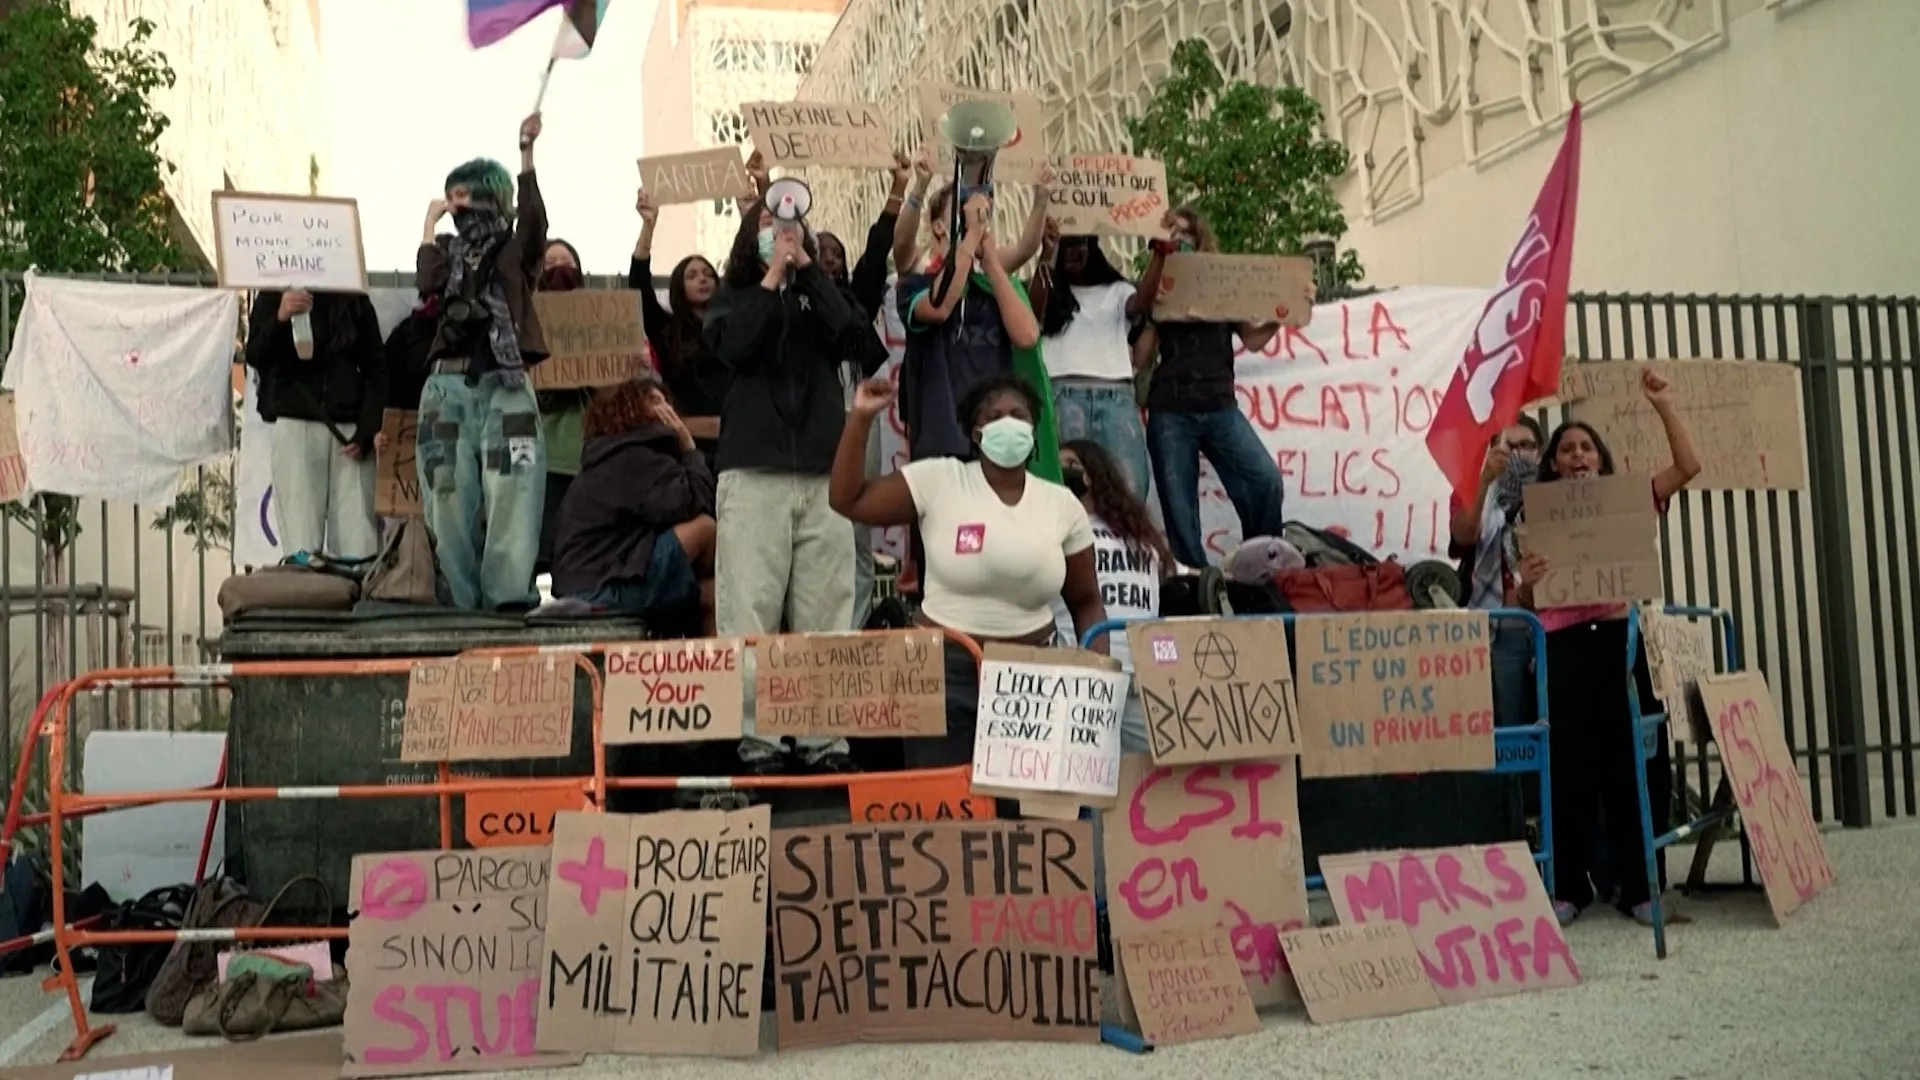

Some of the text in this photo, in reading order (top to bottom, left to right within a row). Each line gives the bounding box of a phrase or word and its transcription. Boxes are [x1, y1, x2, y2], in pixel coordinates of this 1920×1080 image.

[753, 107, 878, 128] MISKINE LA
[1073, 156, 1135, 172] PEUPLE
[653, 160, 744, 198] ANTIFA
[1130, 176, 1157, 192] QUE
[232, 209, 329, 230] POUR UN
[1109, 194, 1161, 225] PREND
[236, 236, 342, 248] MONDE SANS
[1342, 302, 1410, 360] LA
[1277, 449, 1400, 498] FLICS
[905, 643, 928, 669] DU
[1312, 647, 1488, 685] EST UN DROIT
[769, 676, 808, 702] BAC
[829, 671, 873, 698] MAIS
[1383, 685, 1435, 713] PAS
[629, 704, 711, 733] MIND
[768, 700, 902, 728] JUSTE LE VRAC
[1070, 724, 1101, 747] DONC
[1330, 709, 1493, 748] UN PRIVILEGE
[864, 799, 974, 823] COLAS
[630, 889, 724, 945] QUE
[969, 896, 1096, 954] FACHO
[375, 933, 497, 975] SINON
[1128, 936, 1228, 962] TOUT LE
[1147, 965, 1212, 993] MONDE
